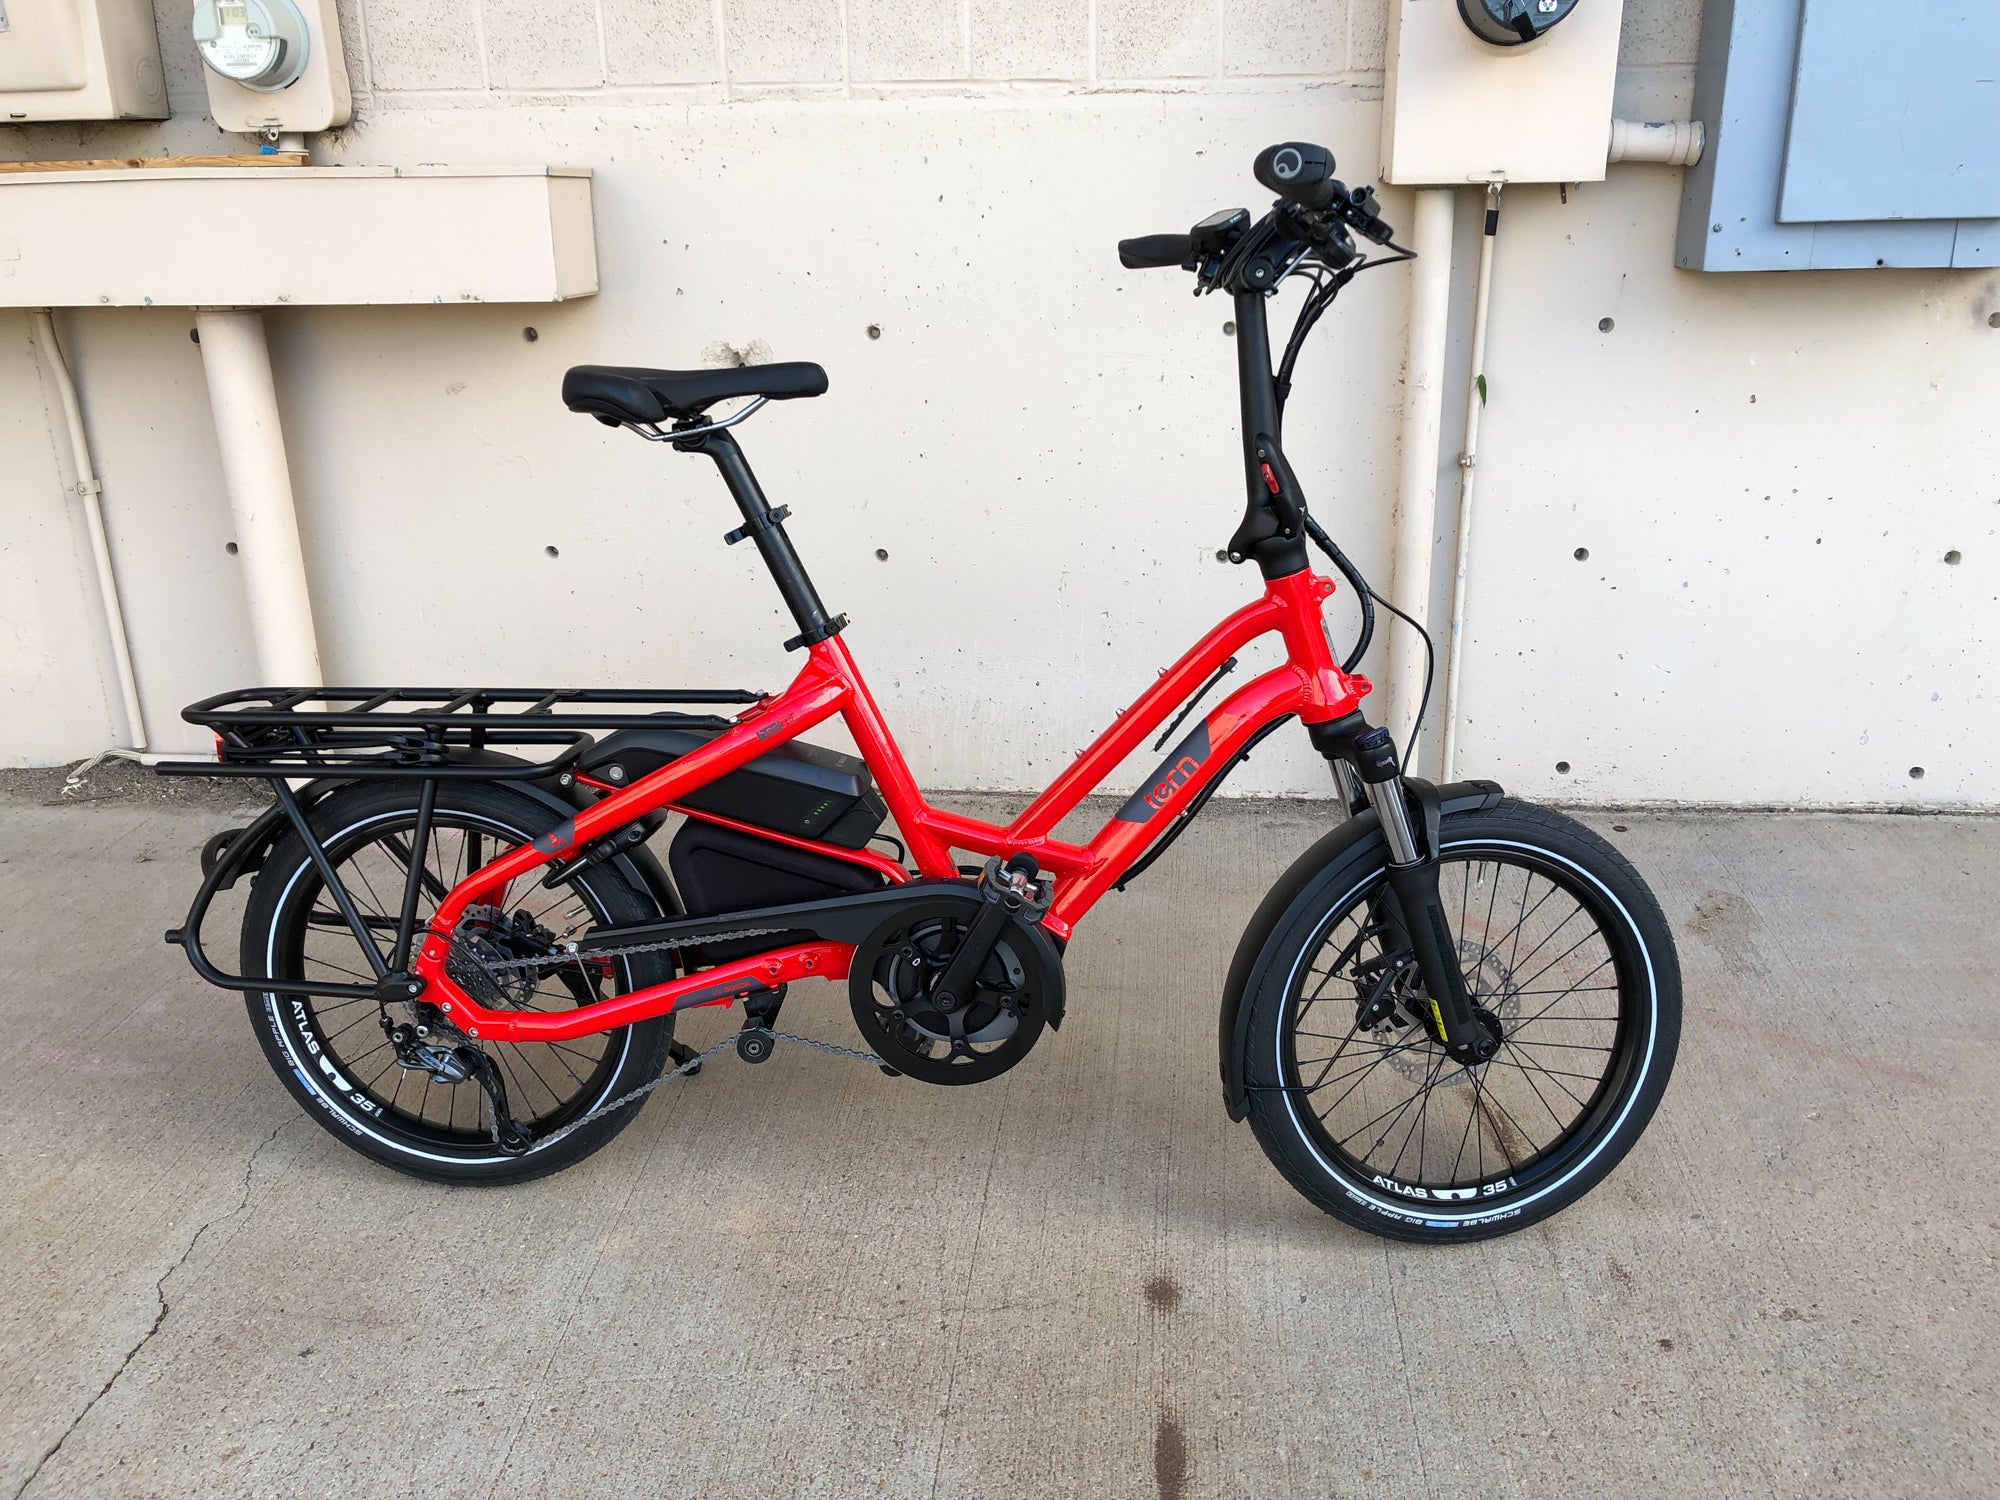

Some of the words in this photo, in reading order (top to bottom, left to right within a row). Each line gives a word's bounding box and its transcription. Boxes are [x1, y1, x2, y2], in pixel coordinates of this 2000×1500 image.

[291, 1000, 320, 1055] ATLAS
[1372, 1175, 1428, 1199] ATLAS
[1367, 1204, 1403, 1220] APPLE
[1404, 1216, 1424, 1225] BIG
[1462, 1208, 1522, 1227] SCHWALBE
